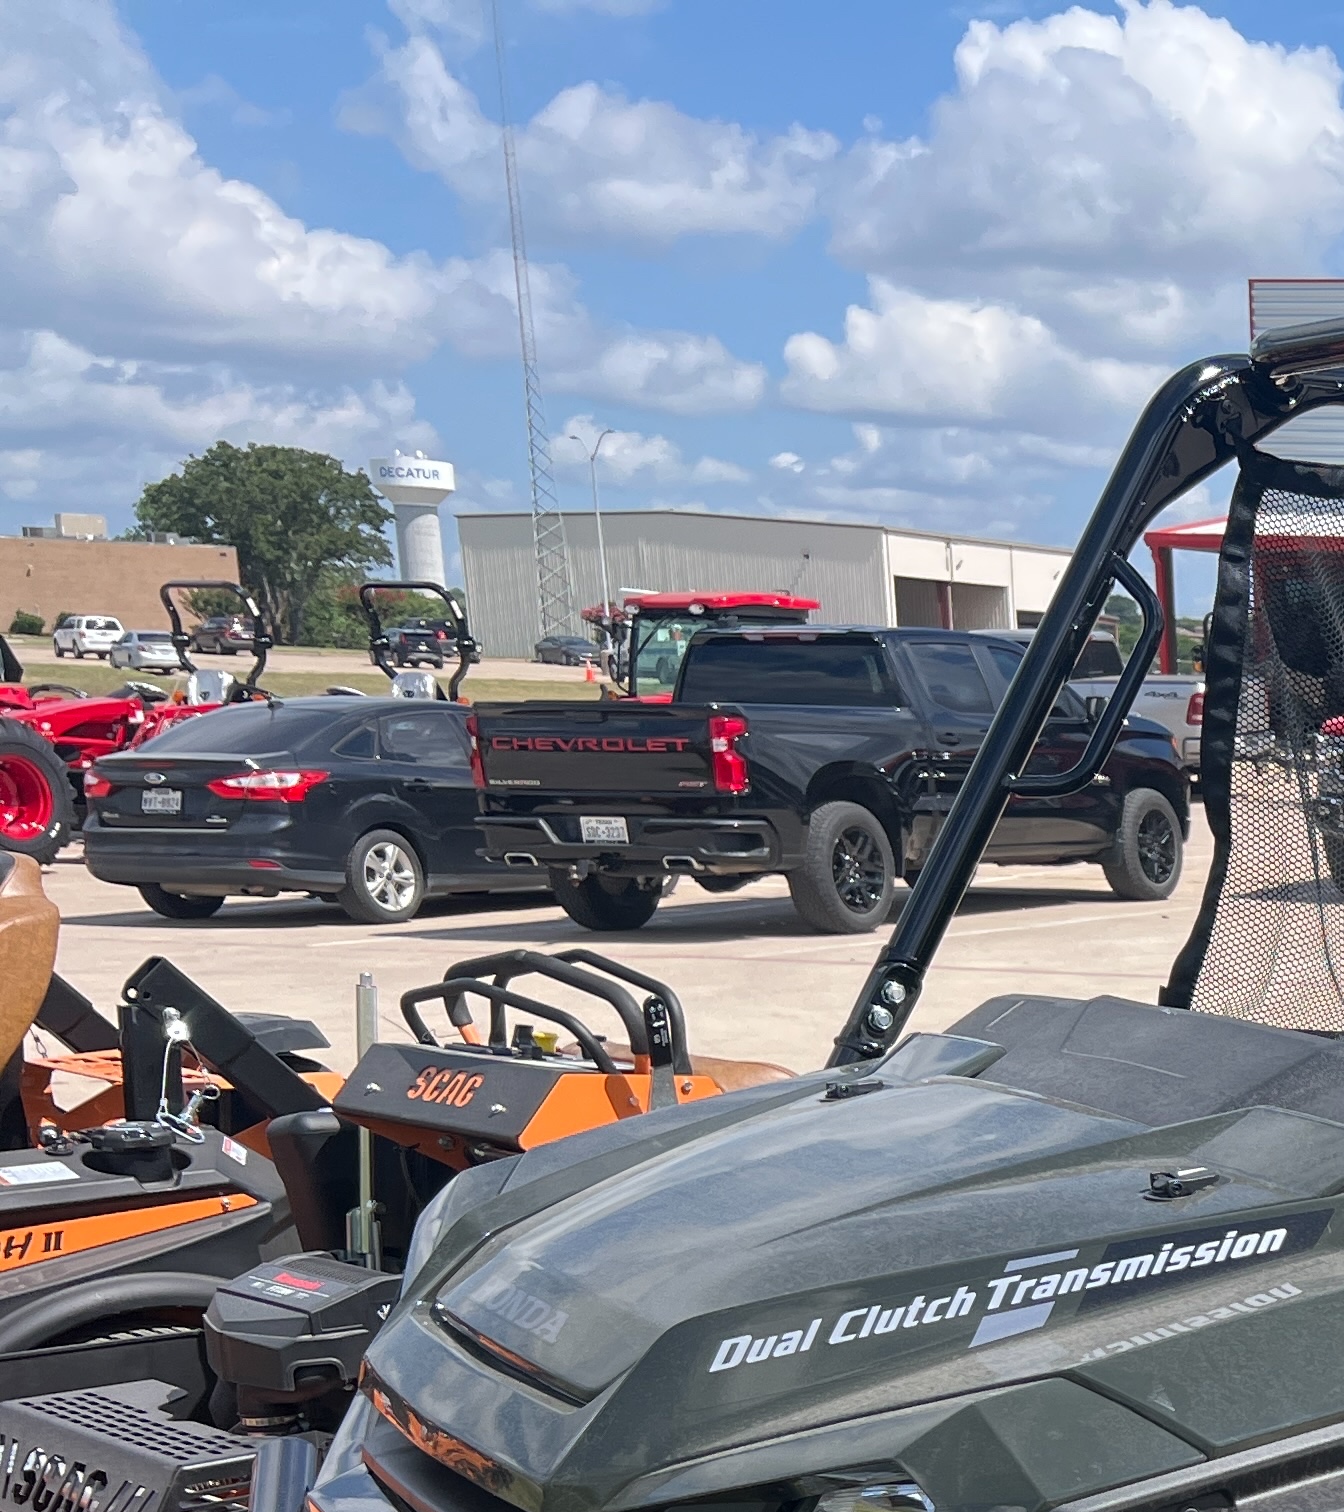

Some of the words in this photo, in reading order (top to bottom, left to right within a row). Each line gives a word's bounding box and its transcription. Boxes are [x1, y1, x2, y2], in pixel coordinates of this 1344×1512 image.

[379, 466, 440, 480] DECATUR
[492, 737, 689, 752] CHEVROLET
[406, 1065, 485, 1108] SCAG
[708, 1318, 823, 1374] Dual
[828, 1285, 977, 1345] Clutch
[985, 1227, 1290, 1311] Transmission
